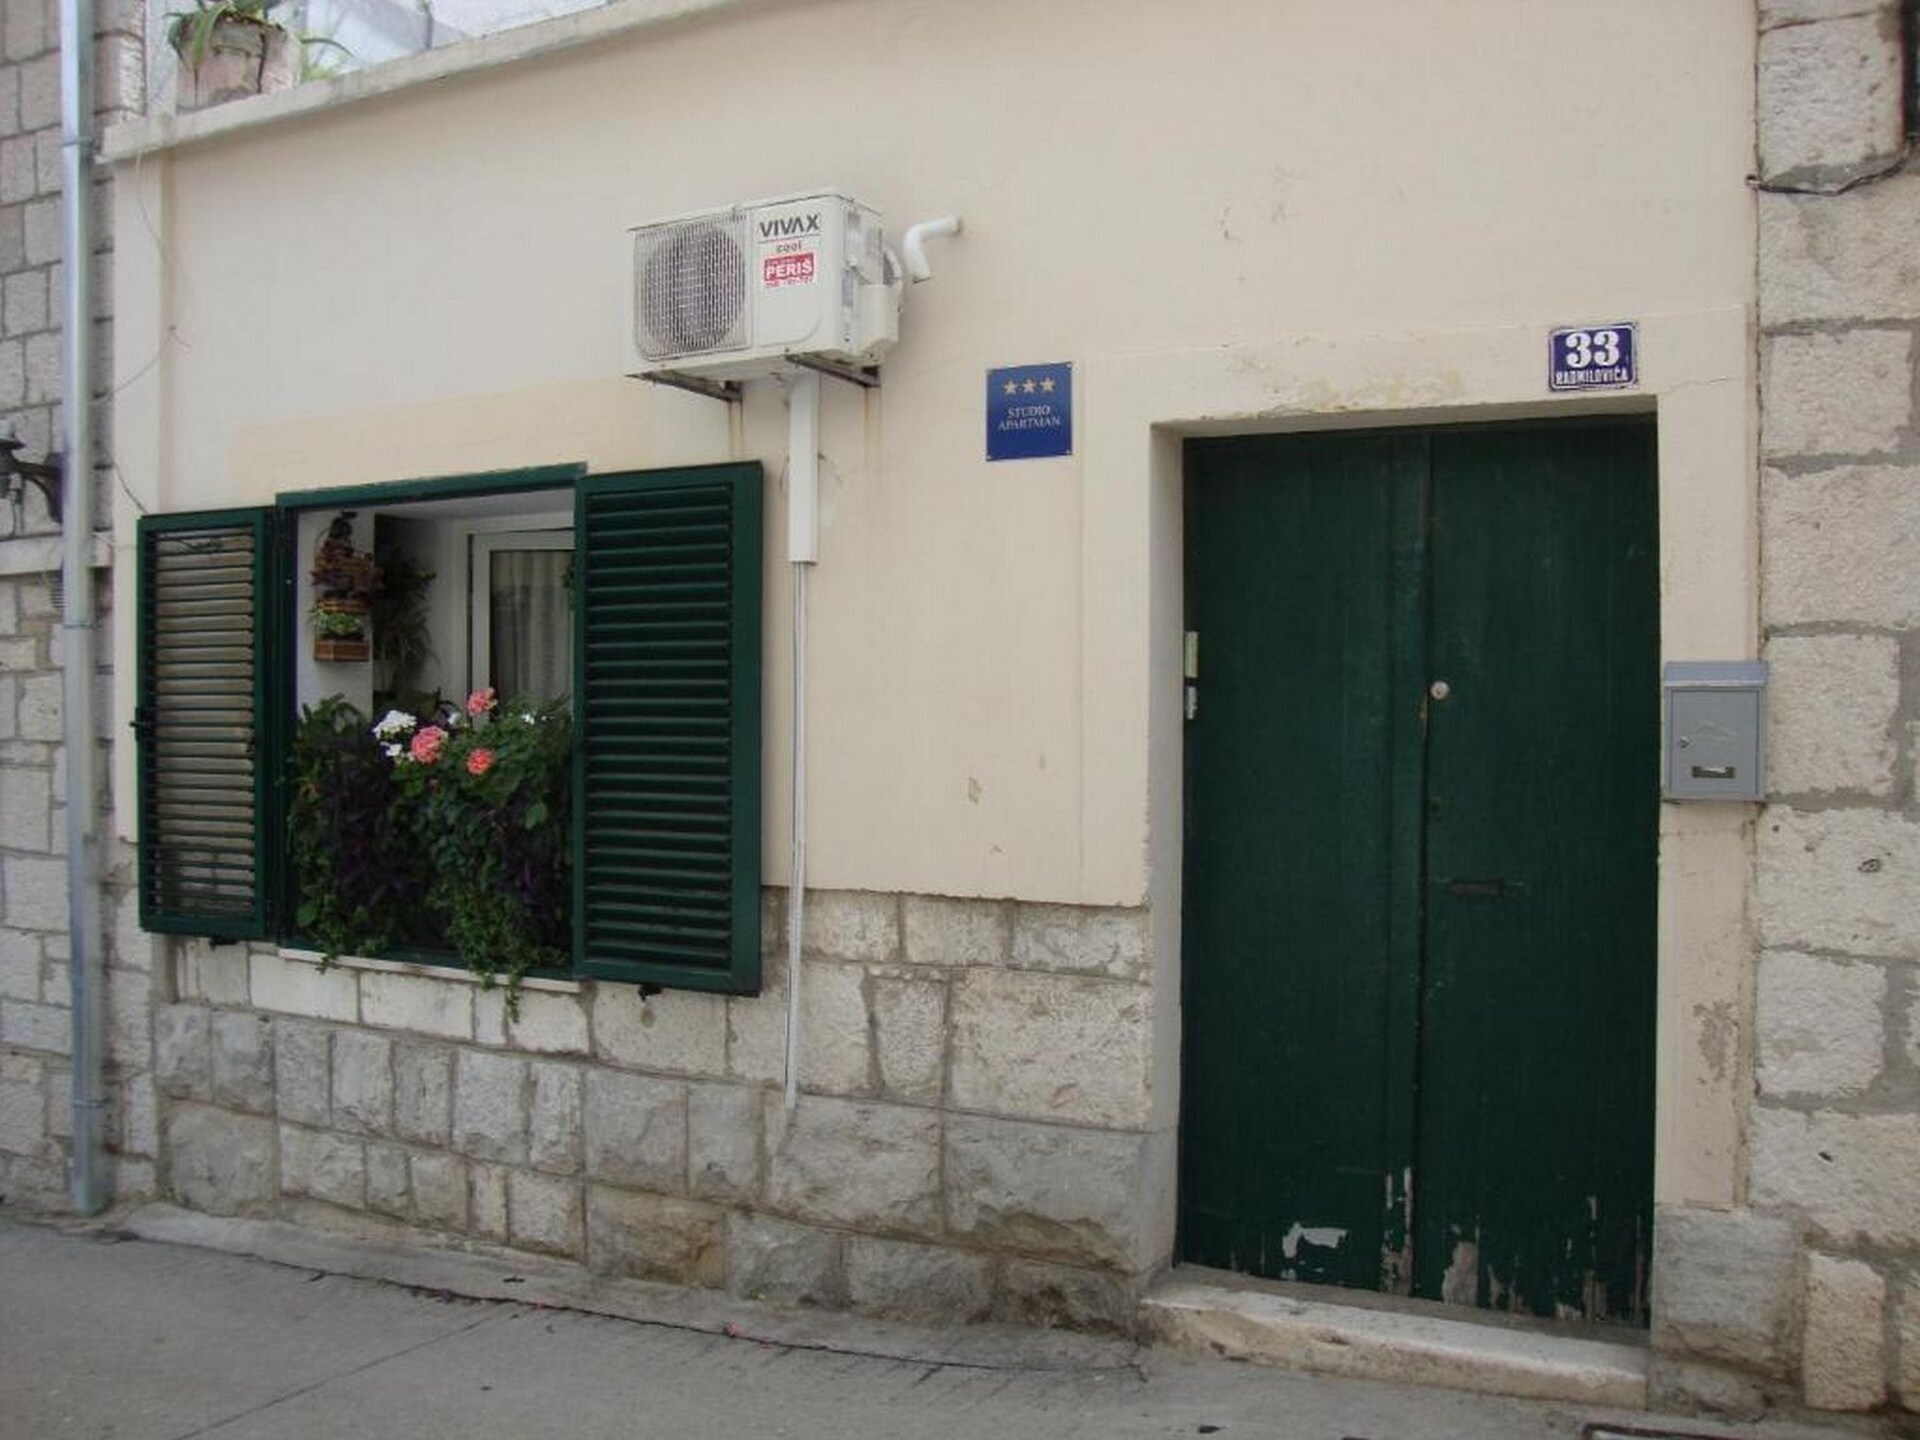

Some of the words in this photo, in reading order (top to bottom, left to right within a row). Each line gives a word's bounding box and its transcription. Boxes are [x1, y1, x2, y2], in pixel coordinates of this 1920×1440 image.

[759, 214, 819, 238] VIVAX
[776, 240, 802, 253] cool
[1566, 330, 1620, 368] 33
[1007, 404, 1051, 418] STUDIO
[997, 416, 1062, 431] APARTMAN
